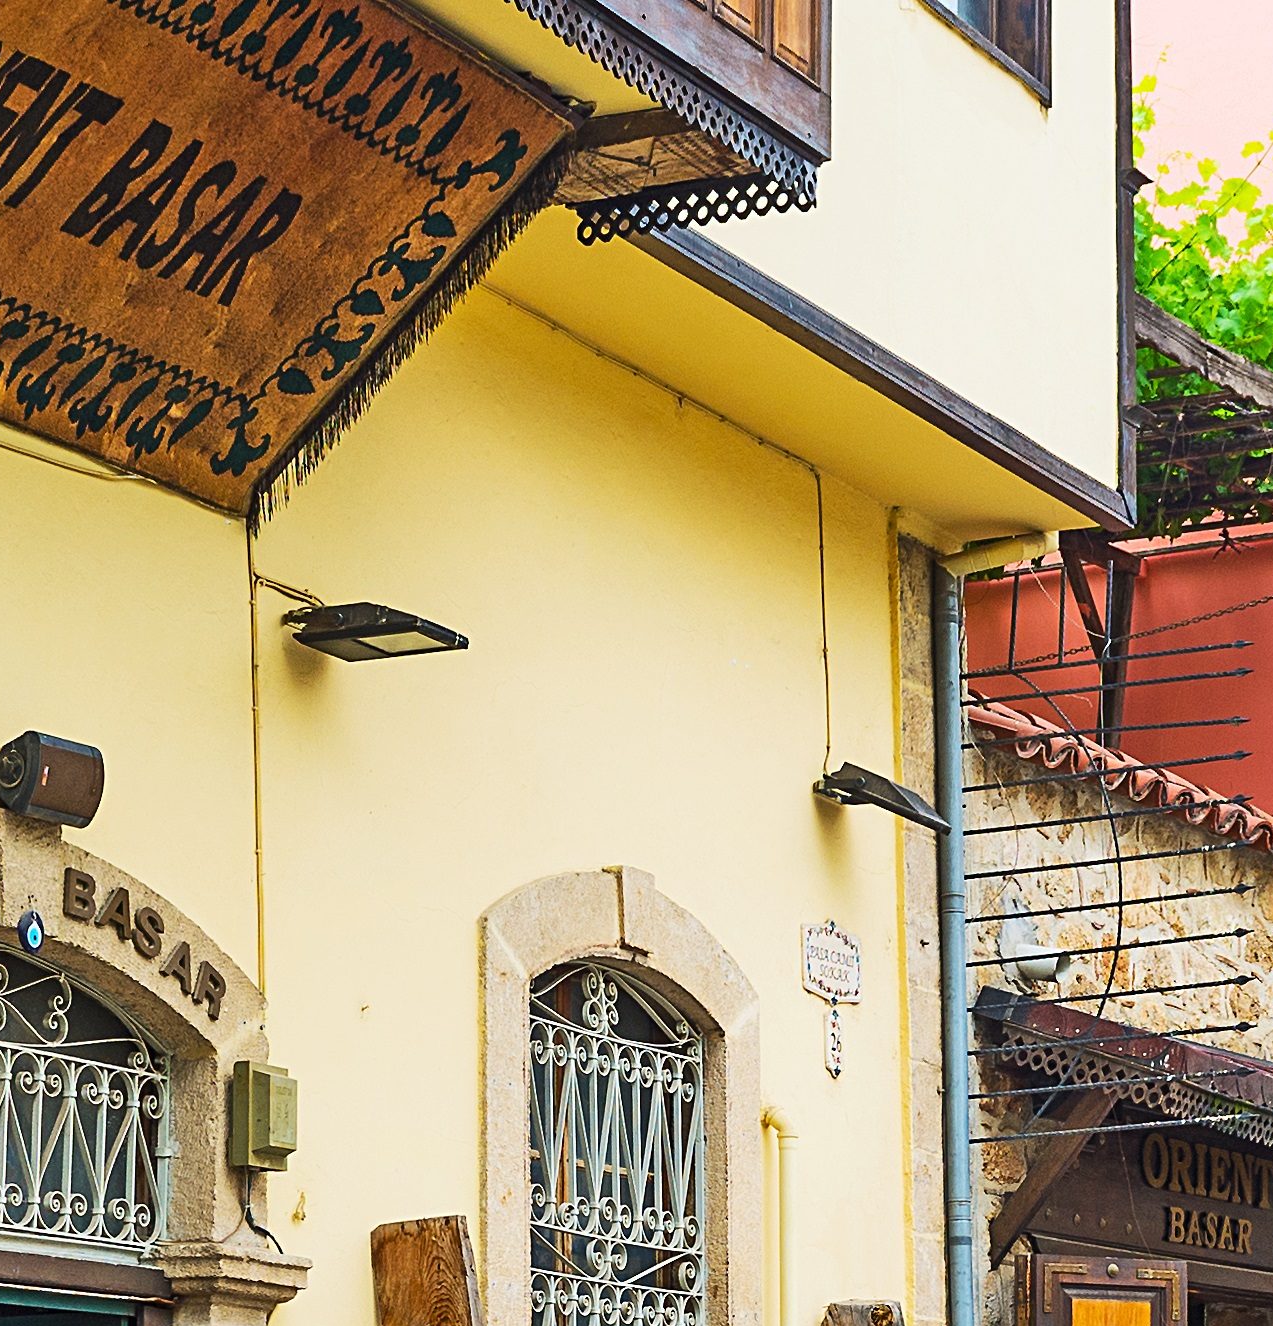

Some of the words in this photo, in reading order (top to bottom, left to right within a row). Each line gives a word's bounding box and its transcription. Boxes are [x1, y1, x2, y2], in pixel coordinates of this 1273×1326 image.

[59, 118, 303, 307] BASAR
[62, 866, 227, 1021] BASAR
[830, 1032, 842, 1053] 26
[1167, 1206, 1254, 1255] BASAR
